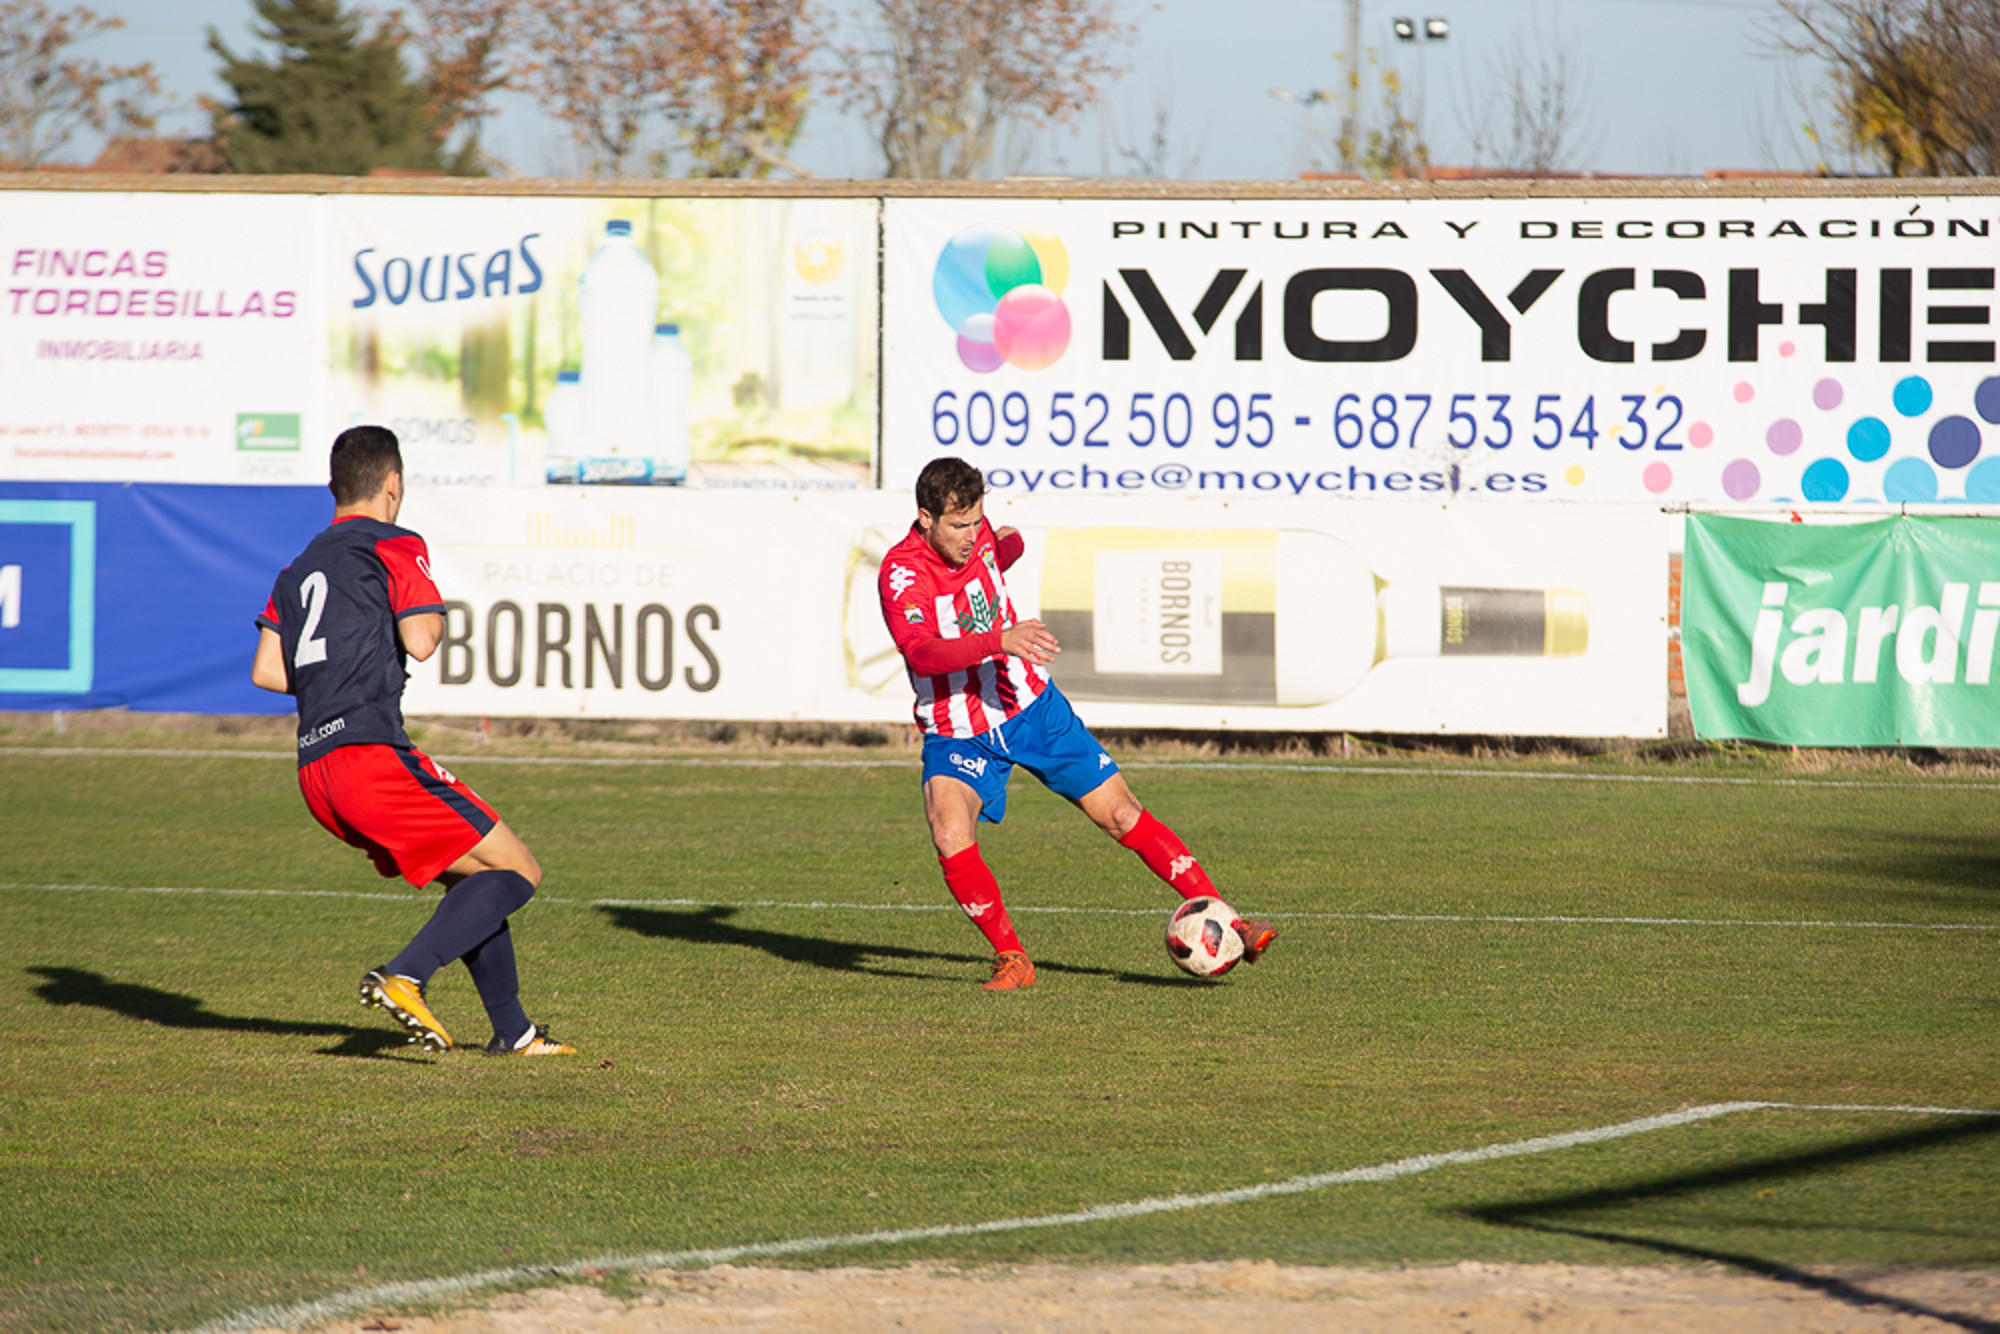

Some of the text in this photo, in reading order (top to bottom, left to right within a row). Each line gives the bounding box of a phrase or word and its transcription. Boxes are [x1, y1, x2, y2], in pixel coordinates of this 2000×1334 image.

[1113, 205, 1989, 239] PINTURA Y DECORACIÓN
[12, 249, 168, 279] FINCAS
[353, 234, 543, 309] SOUSAS
[8, 288, 297, 318] TORDESILLAS
[1103, 268, 1996, 362] MOYCHE
[37, 340, 204, 361] INMOBILIARIA
[391, 416, 477, 444] SOMOS
[933, 390, 1030, 446] 609
[1049, 392, 1109, 447] 52
[1128, 392, 1192, 448] 50
[1212, 393, 1273, 448] 95
[1334, 393, 1433, 449] 687
[1448, 394, 1512, 450] 53
[1533, 395, 1599, 450] 54
[1618, 395, 1684, 451] 32
[988, 464, 1548, 493] oyche@moychesl.es
[484, 561, 674, 588] PALACIO DE
[295, 571, 328, 668] 2
[1160, 561, 1191, 664] BORNOS
[440, 600, 721, 692] BORNOS
